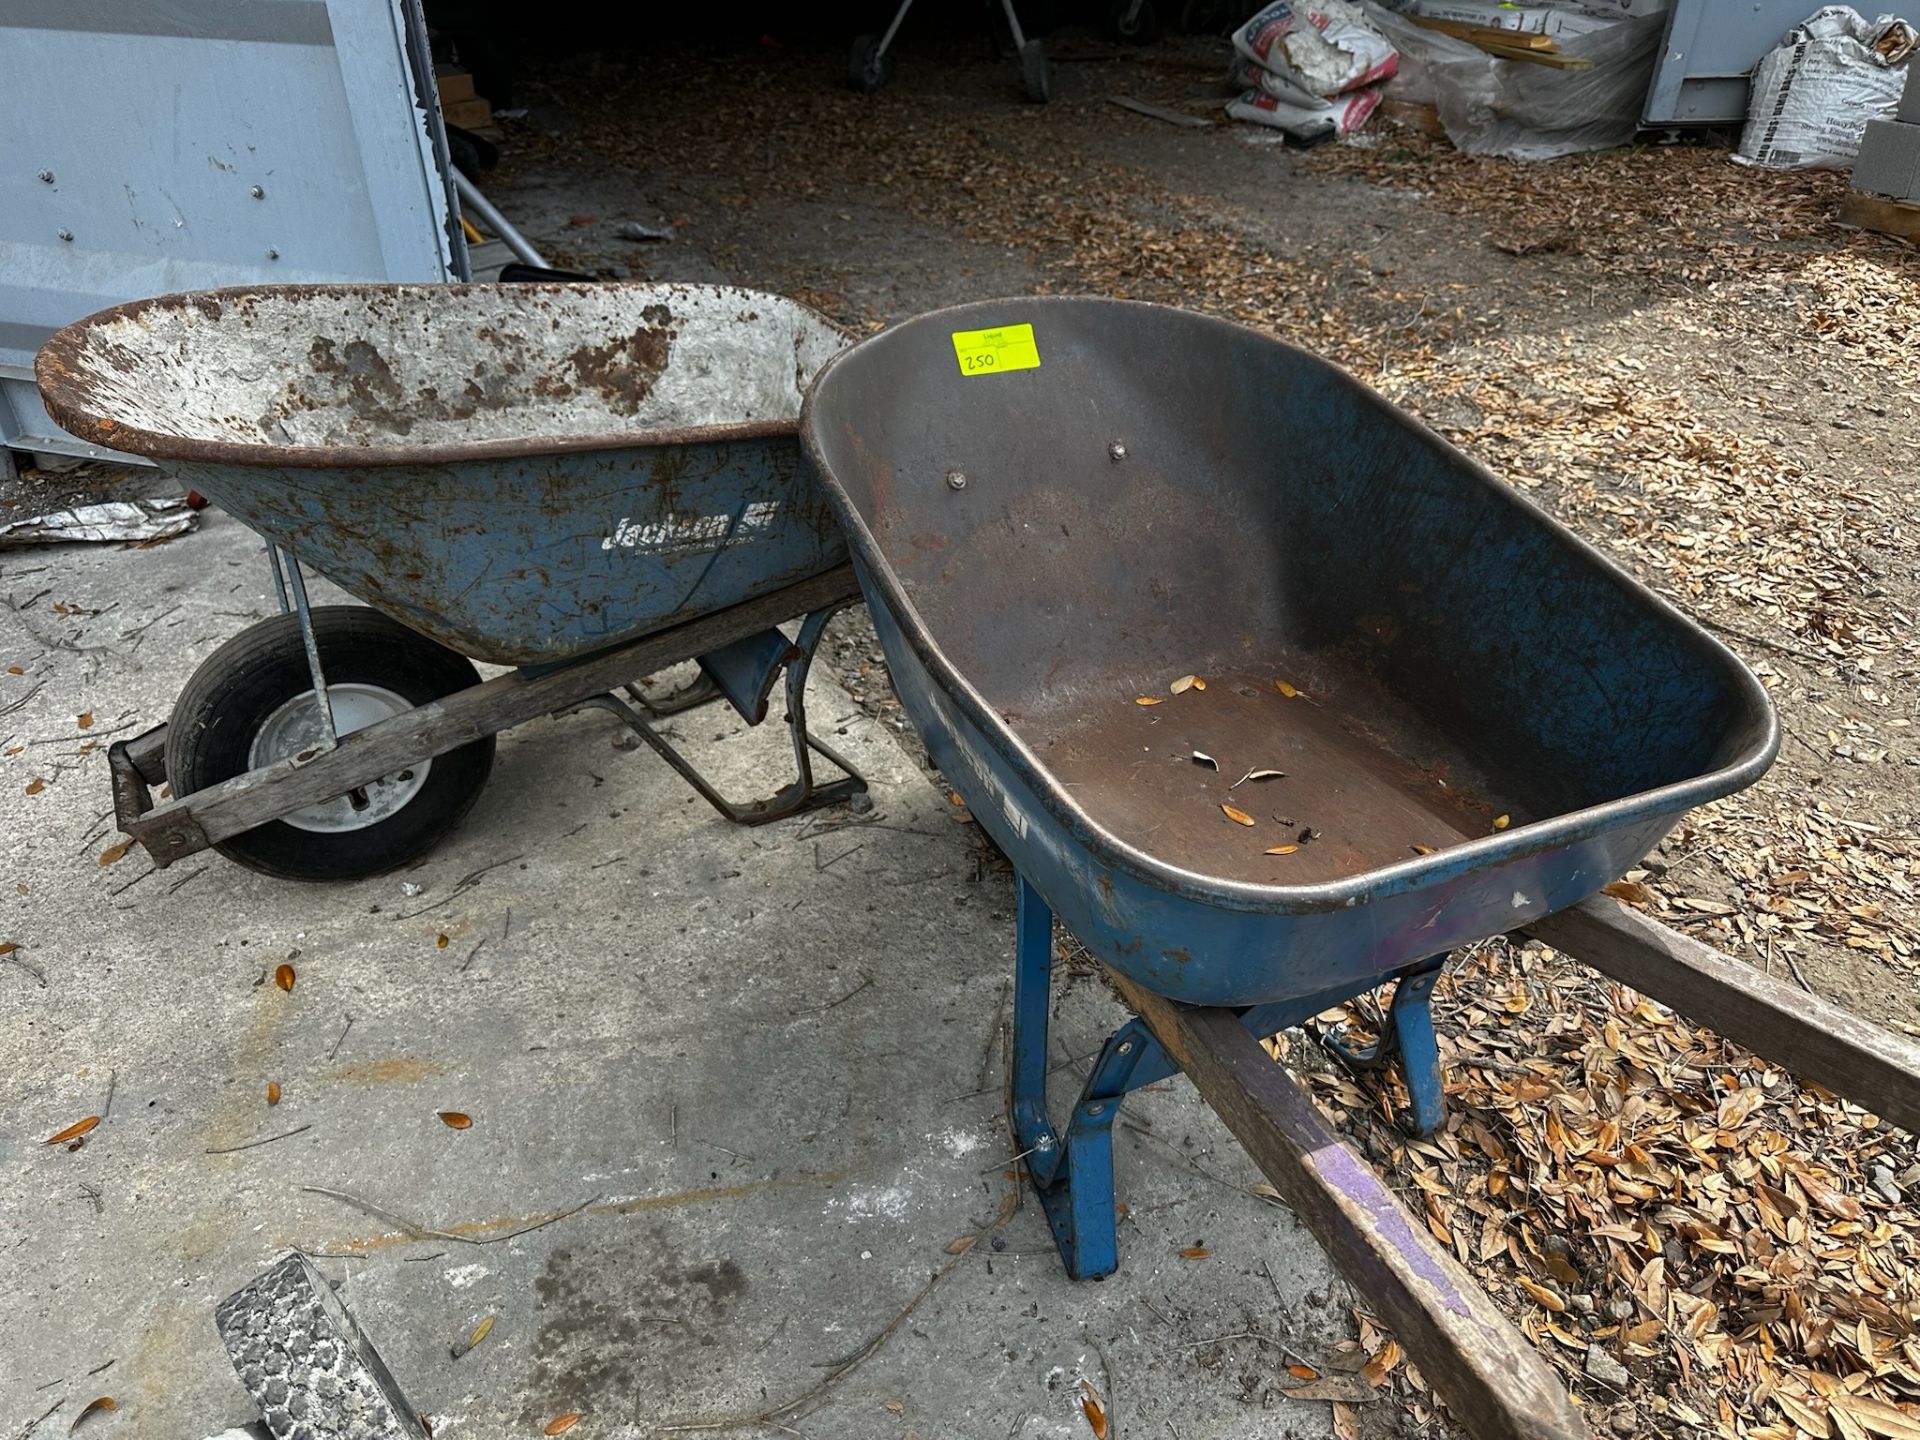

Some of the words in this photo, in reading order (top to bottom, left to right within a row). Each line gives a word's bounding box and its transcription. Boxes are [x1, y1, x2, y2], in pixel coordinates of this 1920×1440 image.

[1779, 68, 1796, 91] BAGS
[1773, 93, 1788, 116] DEMO
[1763, 121, 1779, 143] BAGS
[1826, 117, 1847, 128] Heavy
[1756, 144, 1770, 162] EMO
[965, 354, 994, 370] 250
[602, 513, 729, 550] Jackson
